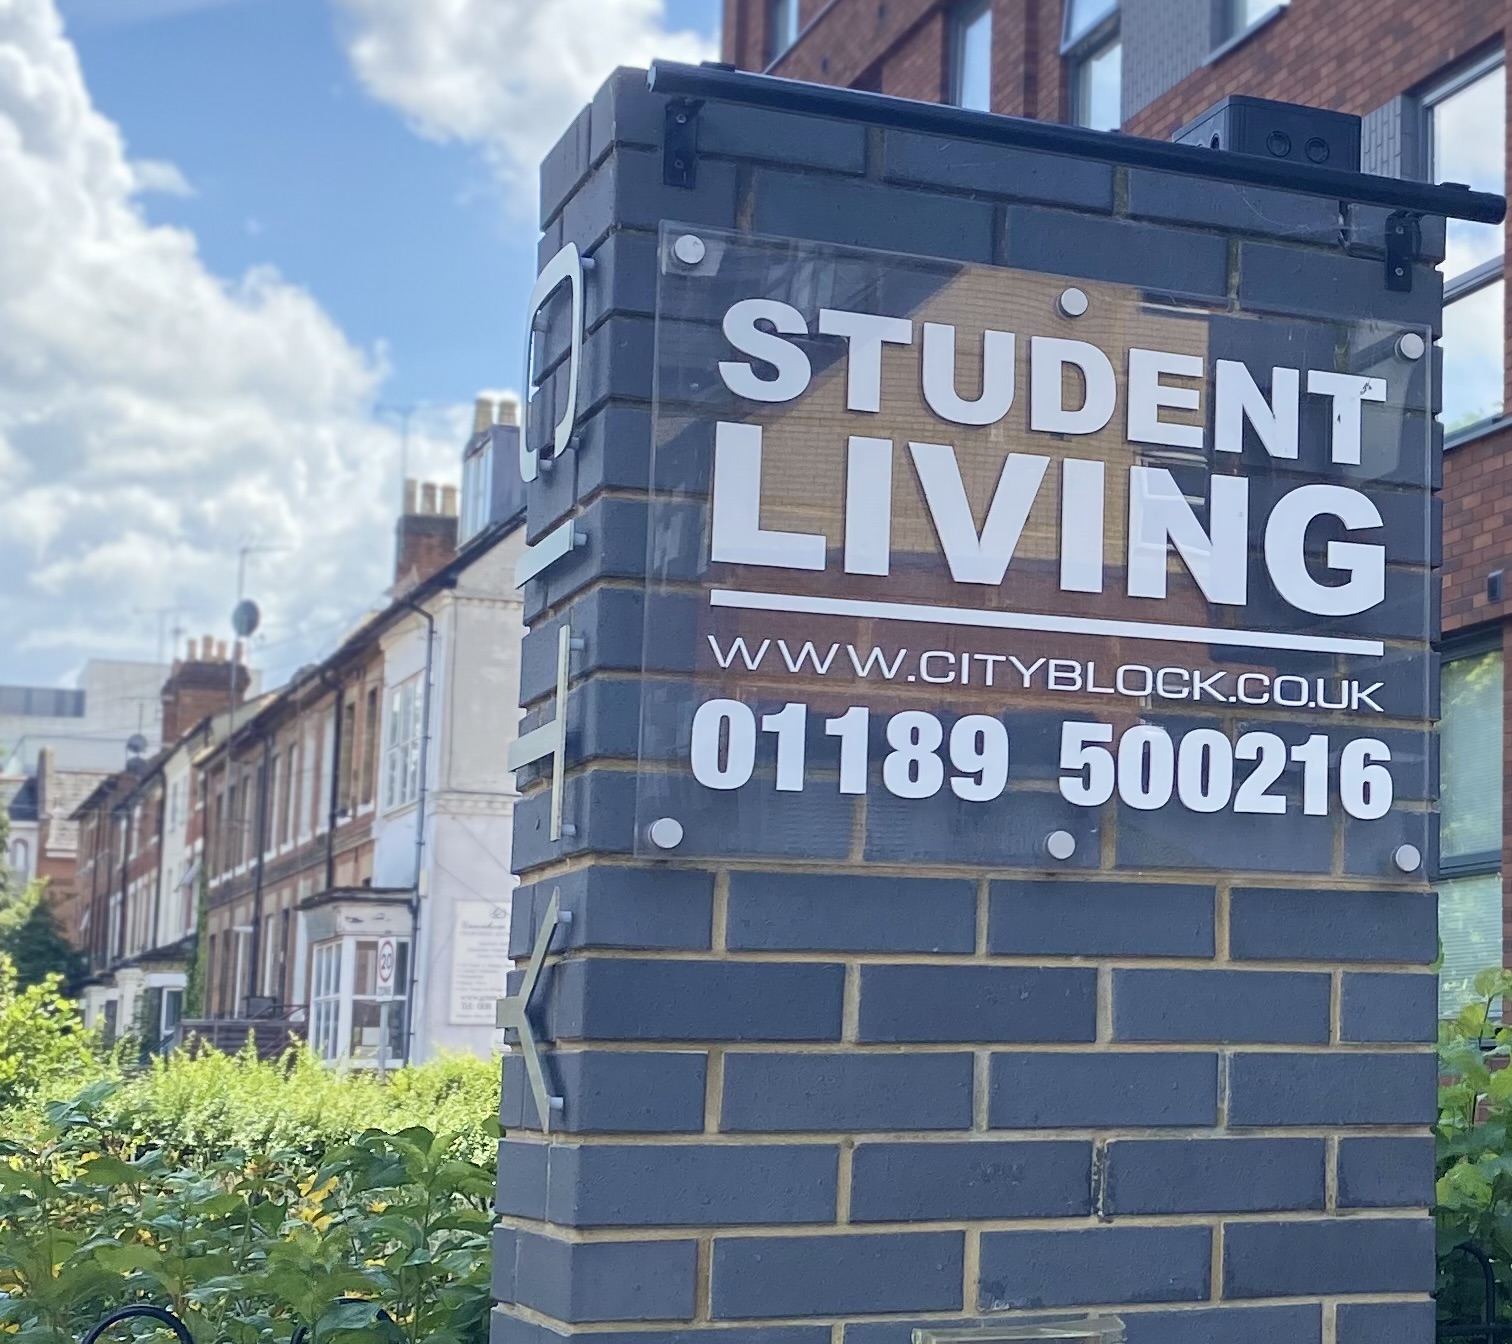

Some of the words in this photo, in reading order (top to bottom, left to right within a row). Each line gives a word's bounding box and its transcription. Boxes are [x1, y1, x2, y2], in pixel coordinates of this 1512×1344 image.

[718, 298, 1386, 465] STUDENT
[711, 421, 1385, 616] LIVING
[708, 634, 1384, 713] WWW.CITYBLOCK.CO.UK
[691, 698, 1009, 802] 01189
[1058, 720, 1393, 820] 500216
